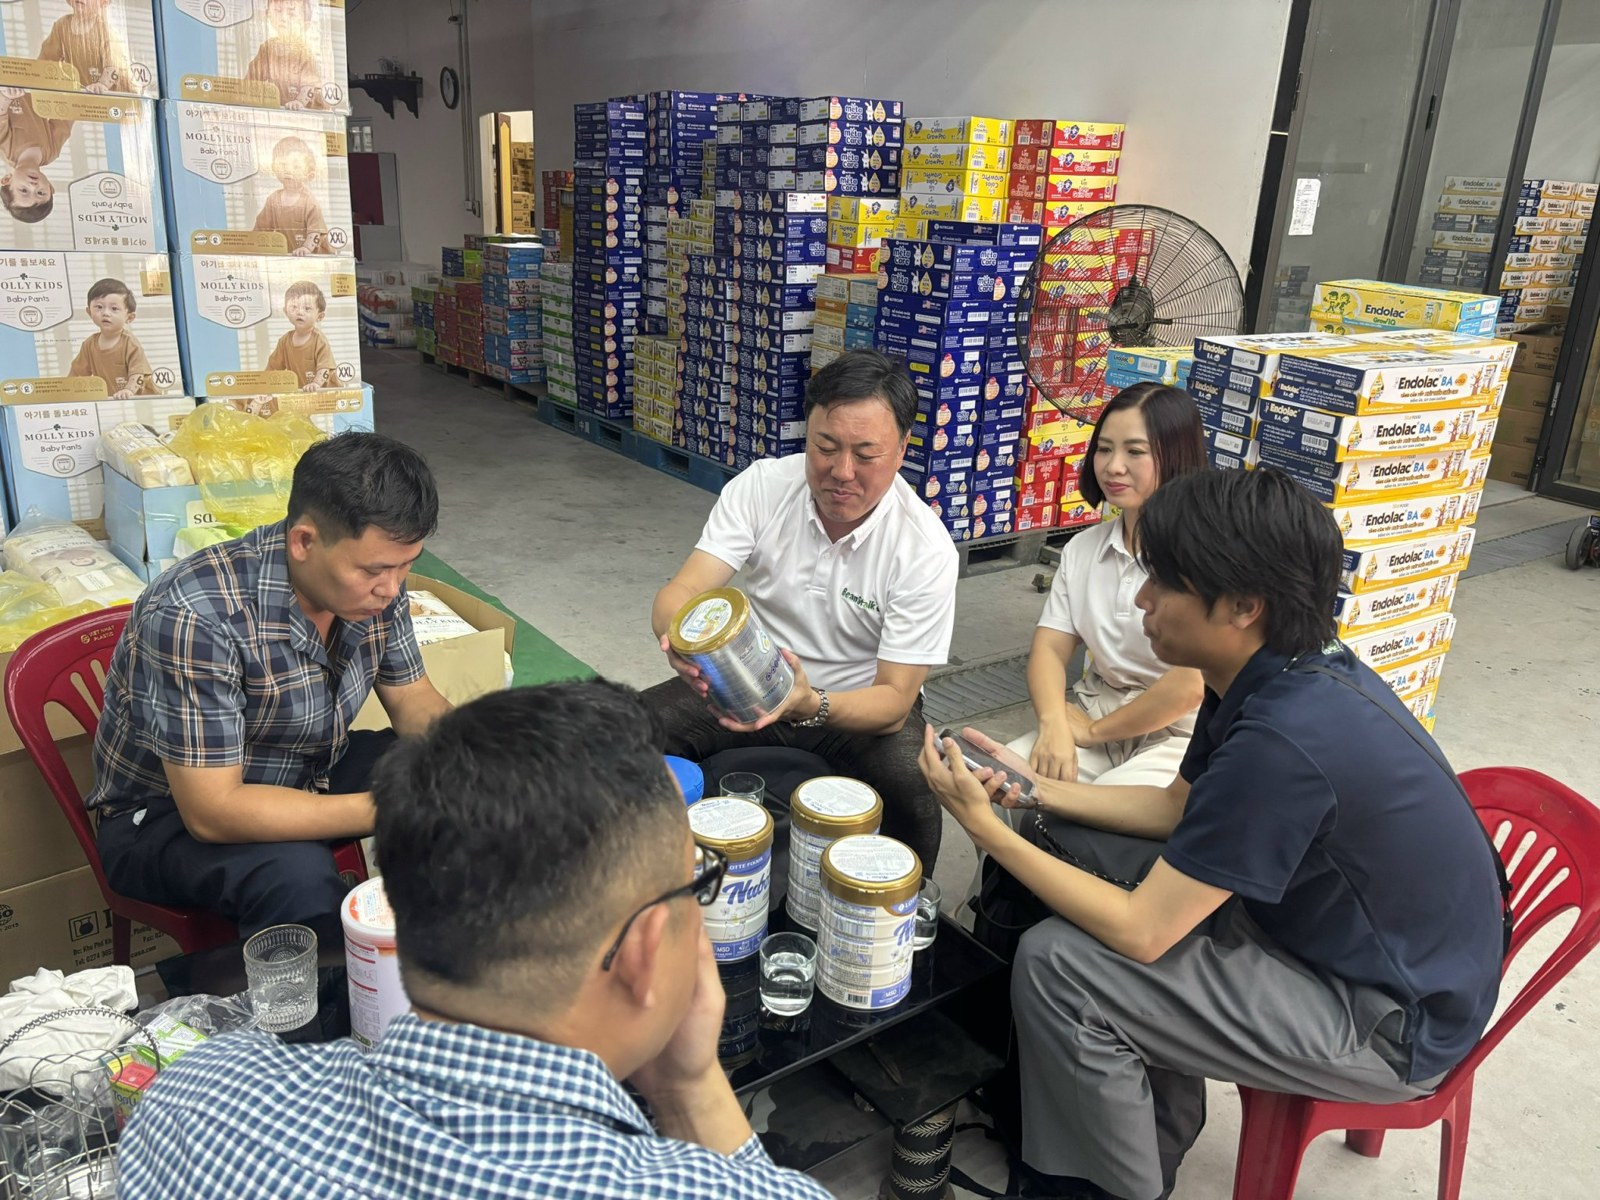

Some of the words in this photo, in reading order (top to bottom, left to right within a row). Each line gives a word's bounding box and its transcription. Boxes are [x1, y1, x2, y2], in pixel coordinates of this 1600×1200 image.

[111, 70, 118, 81] 6
[129, 66, 149, 83] XXL
[306, 87, 314, 98] 6
[324, 85, 340, 101] XXL
[185, 132, 222, 143] MOLLY
[226, 134, 251, 144] KIDS
[200, 147, 218, 157] Baby
[112, 201, 133, 209] Baby
[77, 214, 105, 222] KIDS
[108, 214, 148, 224] MOLLY
[313, 234, 320, 244] 6
[329, 231, 345, 245] XXL
[0, 257, 17, 266] 기를
[0, 281, 31, 290] OLLY
[35, 280, 63, 289] KIDS
[200, 282, 237, 290] MOLLY
[240, 281, 264, 290] KIDS
[6, 294, 27, 303] Baby
[1364, 304, 1405, 319] Endolac
[1203, 342, 1228, 356] Endolac
[154, 371, 173, 385] XXL
[322, 371, 330, 379] 6
[338, 366, 353, 378] XXL
[136, 376, 144, 386] 6
[1398, 375, 1439, 390] Endolac
[1440, 376, 1453, 386] BA
[1195, 380, 1219, 395] Endolac
[1280, 383, 1300, 394] Endolac
[1270, 403, 1299, 418] Endolac
[24, 432, 66, 442] MOLLY
[68, 430, 95, 439] KIDS
[1376, 423, 1417, 438] Endolac
[1418, 424, 1431, 434] BA
[40, 444, 61, 453] Baby
[61, 443, 82, 451] Pants
[1373, 463, 1412, 477] Endolac
[1413, 462, 1425, 472] BA
[1365, 511, 1404, 526] Endolac
[1406, 511, 1419, 521] BA
[1389, 550, 1423, 567] Endolac
[1423, 549, 1434, 560] BA
[1371, 595, 1404, 612] Endolac
[1404, 591, 1415, 602] BA
[94, 632, 114, 641] PLASTIC
[1370, 639, 1403, 656] Endolac
[1403, 636, 1414, 647] BA
[1396, 673, 1407, 686] BA
[729, 863, 746, 871] OTTE
